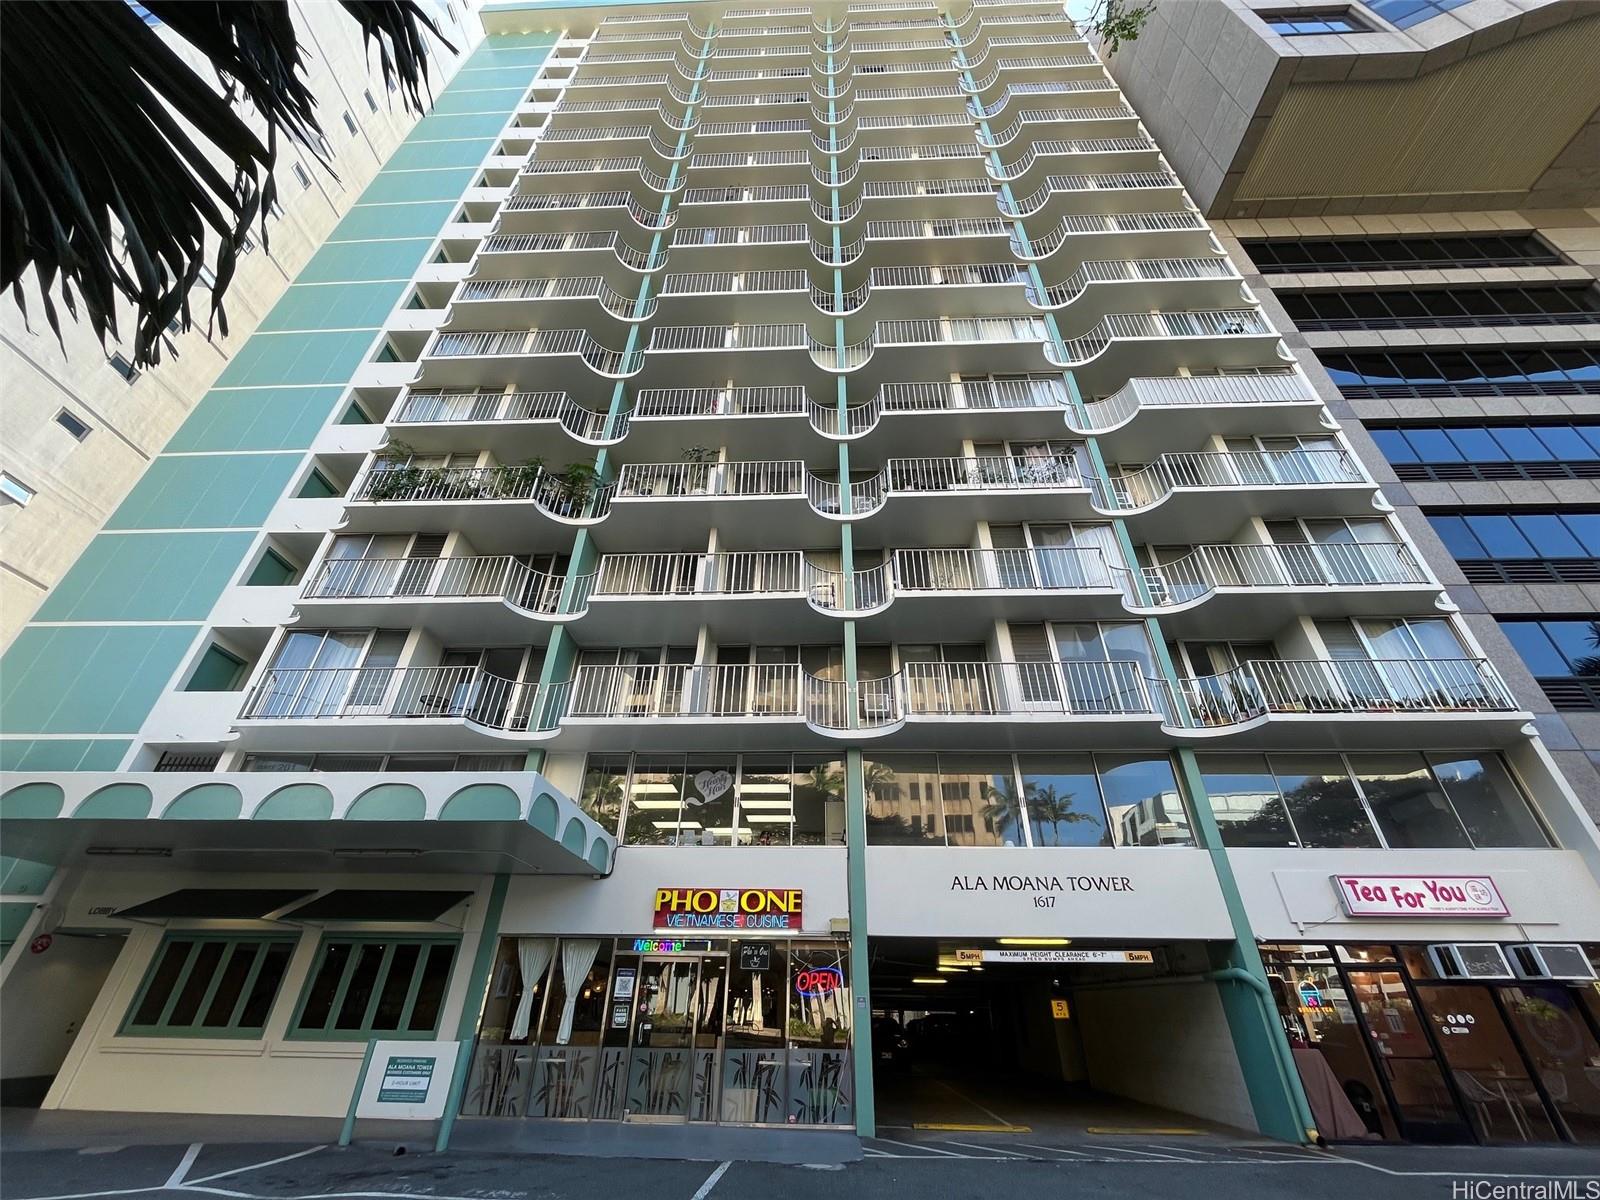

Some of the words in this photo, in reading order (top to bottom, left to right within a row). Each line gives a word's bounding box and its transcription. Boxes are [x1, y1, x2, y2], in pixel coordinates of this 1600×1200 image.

[951, 876, 988, 890] ALA
[993, 876, 1064, 891] MOANA
[1066, 876, 1134, 891] TOWER
[655, 890, 718, 912] PHO
[740, 890, 802, 912] ONE
[1344, 880, 1388, 902] Tea
[1389, 886, 1426, 908] For
[1422, 880, 1467, 902] You
[1033, 896, 1056, 908] 1617
[88, 906, 118, 915] LOBBY
[666, 914, 741, 928] VIETNAMESE
[746, 914, 789, 928] CUISINE
[797, 972, 839, 991] OPEN
[1056, 1002, 1064, 1012] 5
